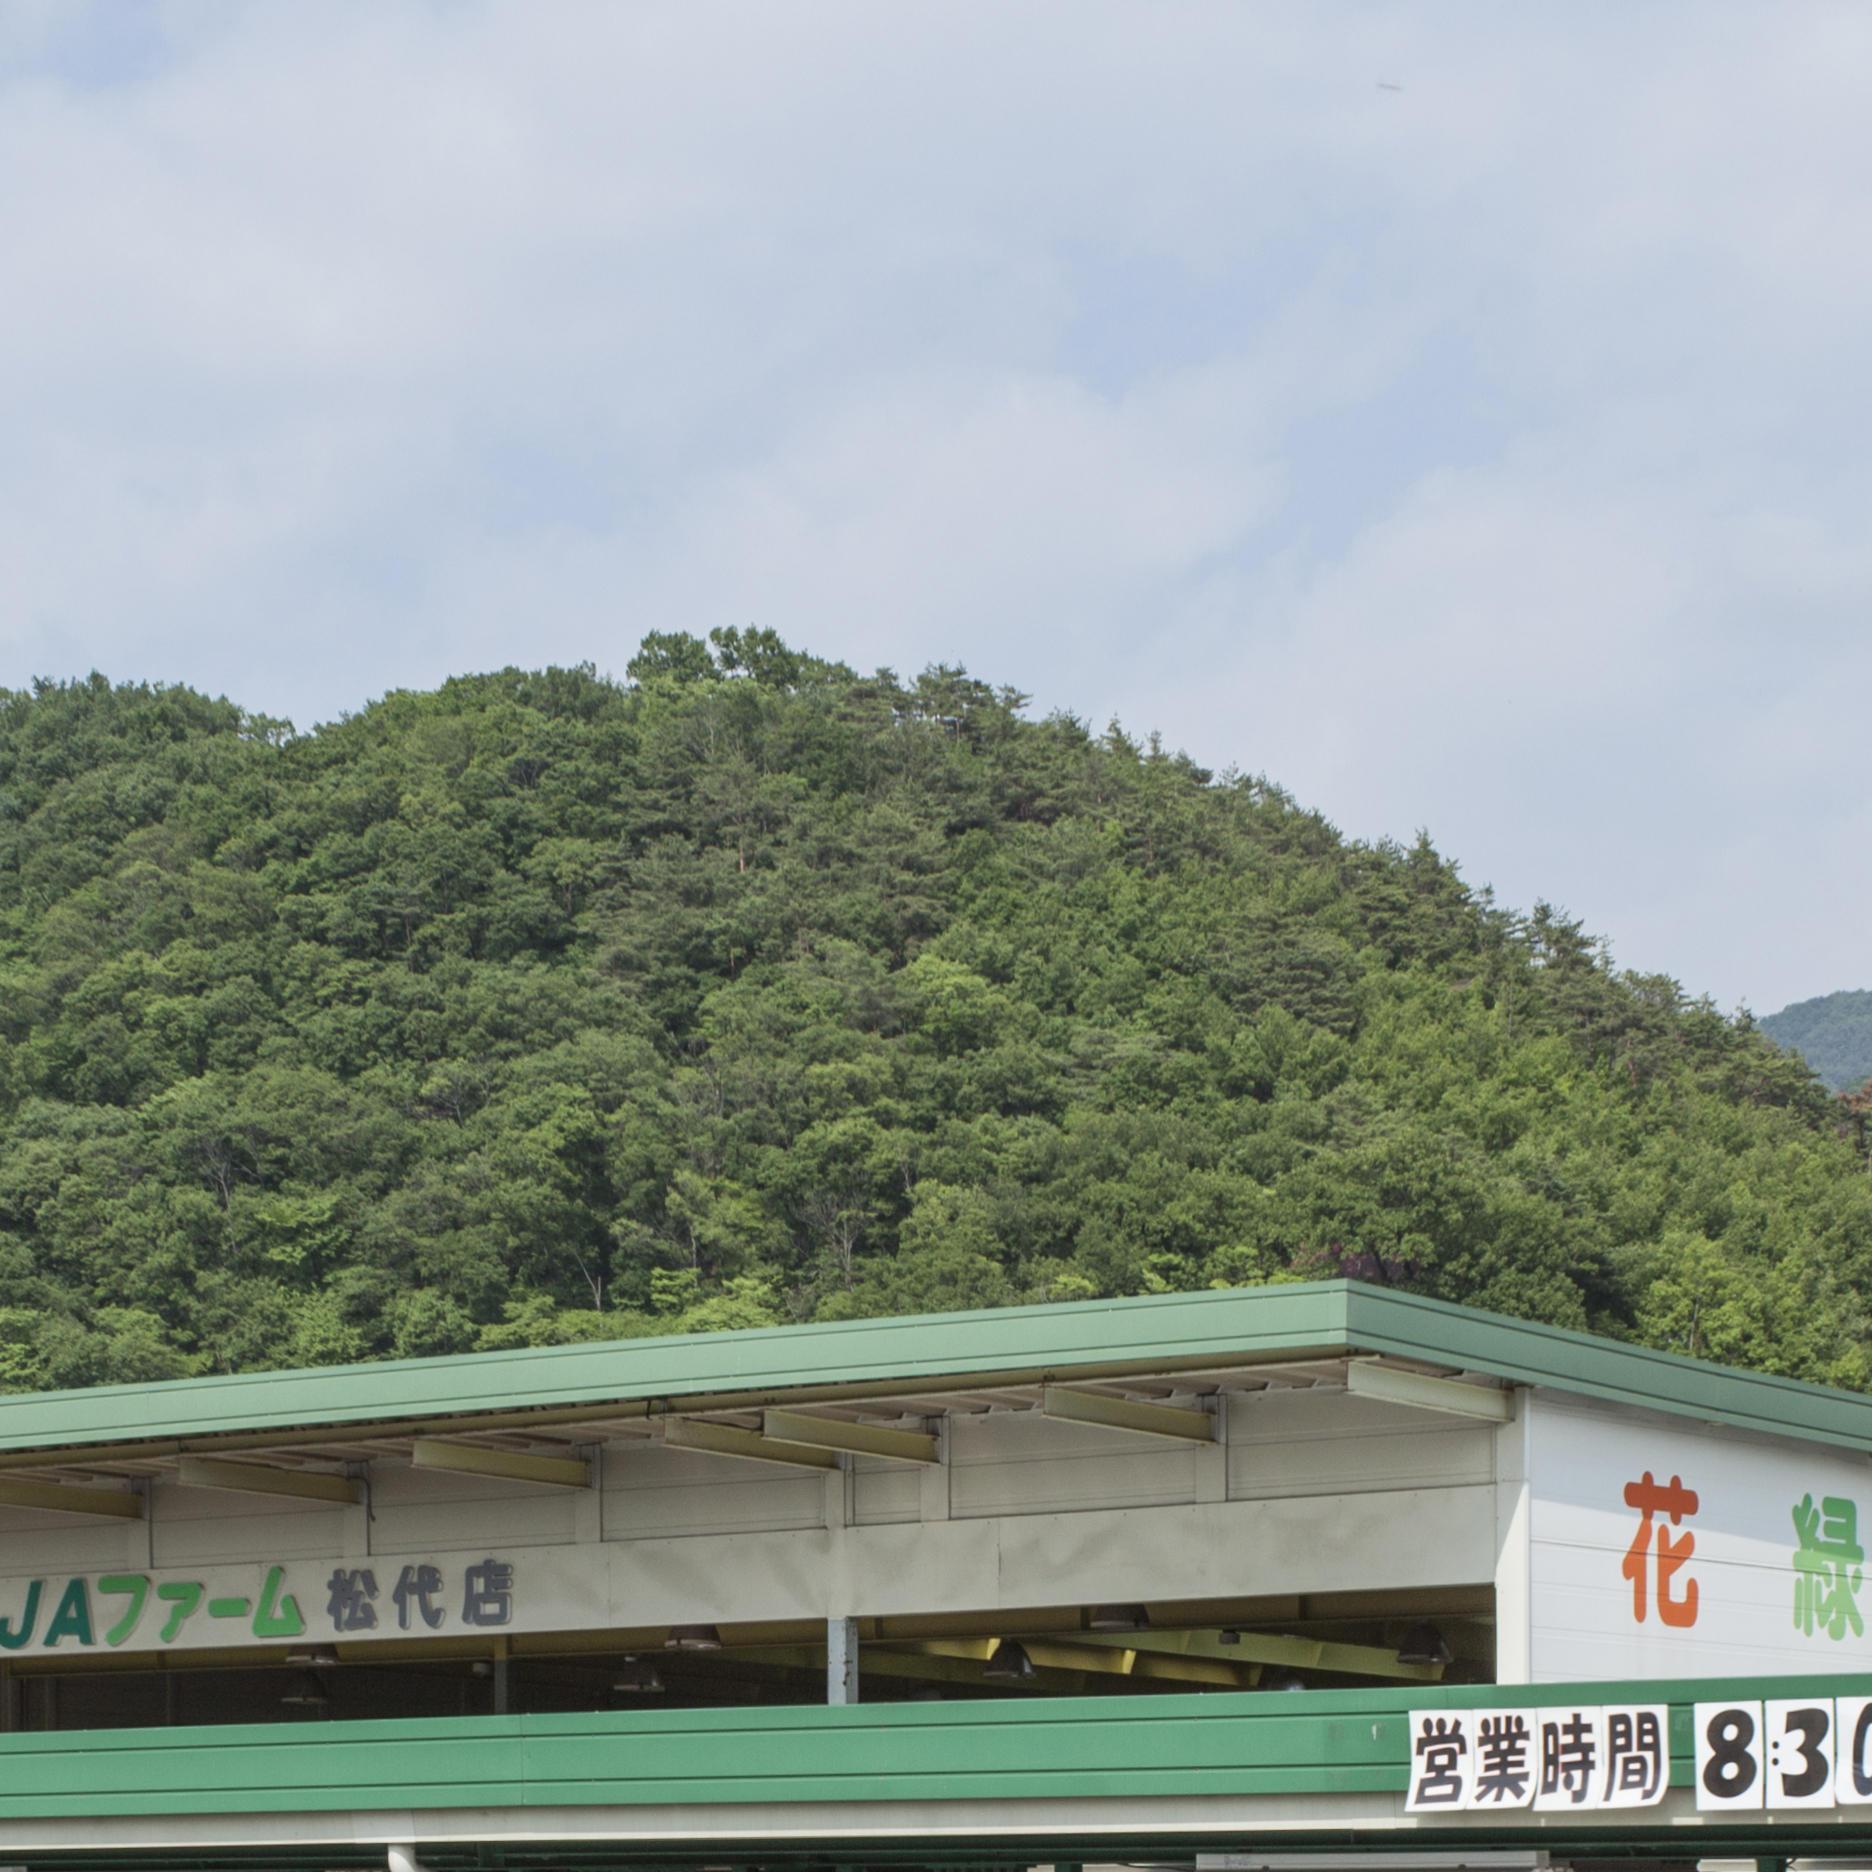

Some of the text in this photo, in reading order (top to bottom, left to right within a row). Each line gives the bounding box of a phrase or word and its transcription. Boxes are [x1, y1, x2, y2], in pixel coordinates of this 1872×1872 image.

[327, 1559, 514, 1633] 松代店
[1623, 1470, 1865, 1641] 花 緑
[1413, 1712, 1660, 1806] 営業時間
